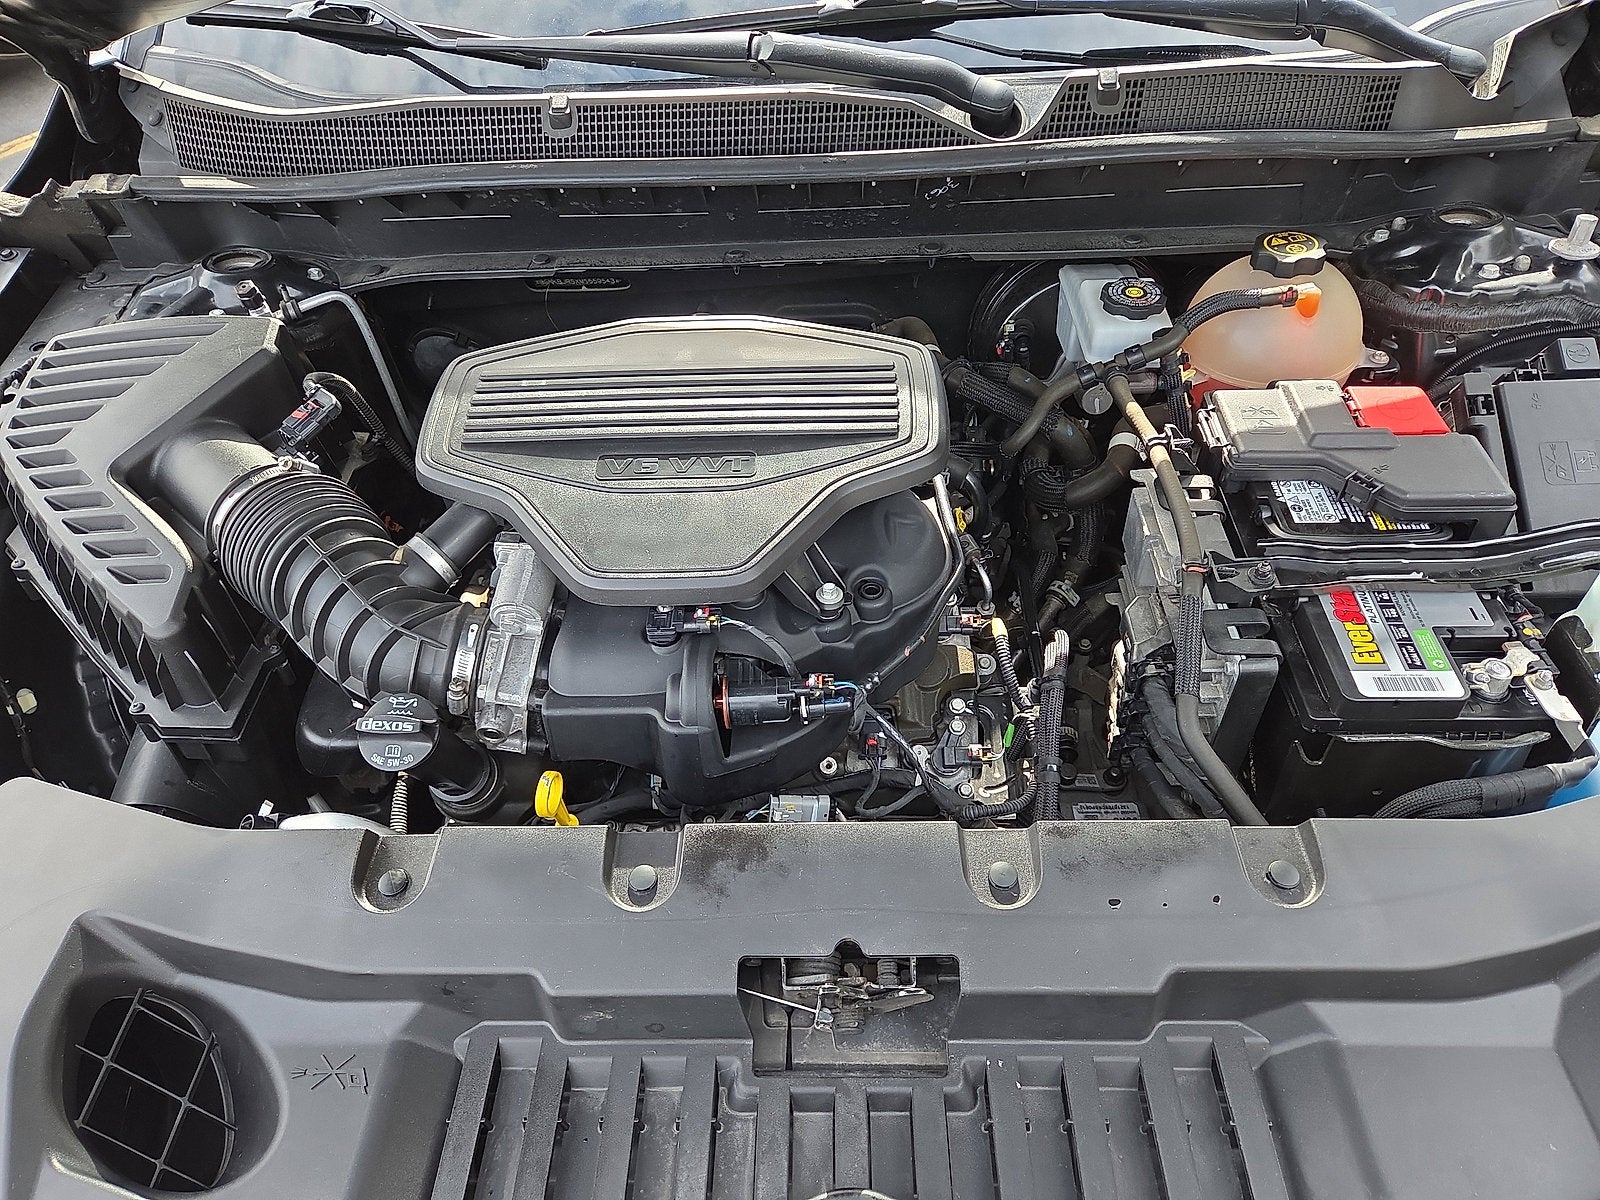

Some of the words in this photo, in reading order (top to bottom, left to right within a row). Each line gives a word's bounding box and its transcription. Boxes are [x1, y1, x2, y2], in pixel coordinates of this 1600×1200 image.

[604, 457, 659, 474] V6
[668, 456, 752, 473] VVT
[1357, 591, 1380, 624] PLATINU
[1330, 591, 1385, 665] EverSta
[361, 718, 416, 732] dexos
[370, 753, 386, 766] SAE
[386, 754, 414, 767] 5W-30
